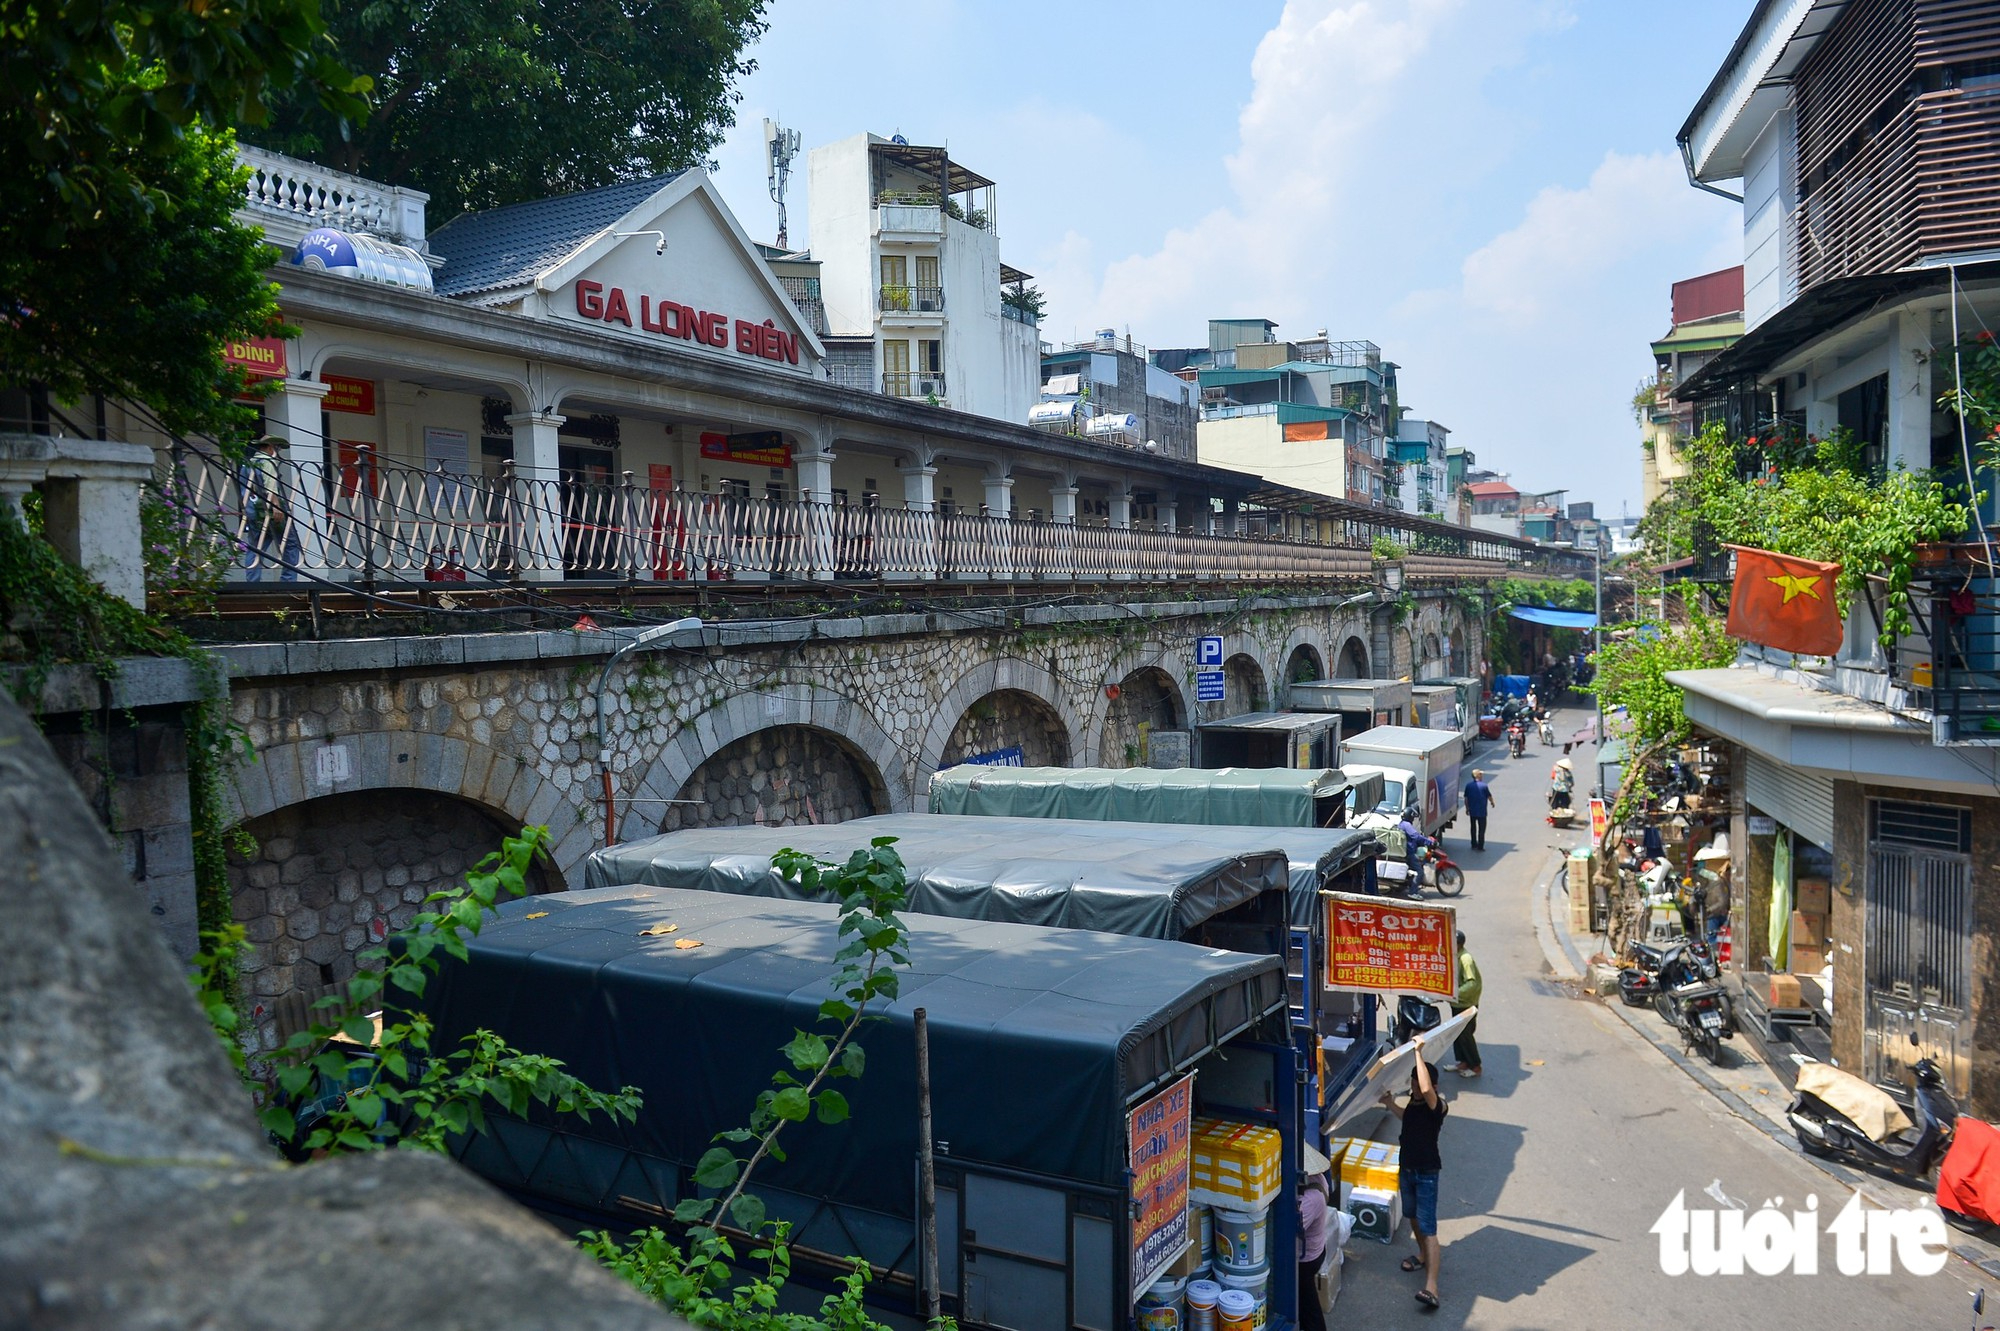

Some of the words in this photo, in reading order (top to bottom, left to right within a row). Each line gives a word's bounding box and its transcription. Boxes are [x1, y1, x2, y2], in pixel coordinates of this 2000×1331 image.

[576, 280, 632, 327] GA
[641, 295, 728, 348] LONG
[736, 319, 798, 365] BIÊN
[233, 343, 275, 364] ĐÌNH
[1201, 640, 1219, 663] P
[1840, 862, 1853, 895] 2
[1338, 909, 1375, 926] XE
[1382, 914, 1440, 931] QUÝ
[1388, 932, 1417, 942] NINH
[1368, 948, 1390, 958] 99C
[1368, 957, 1390, 967] 99C
[1169, 1088, 1184, 1114] XE
